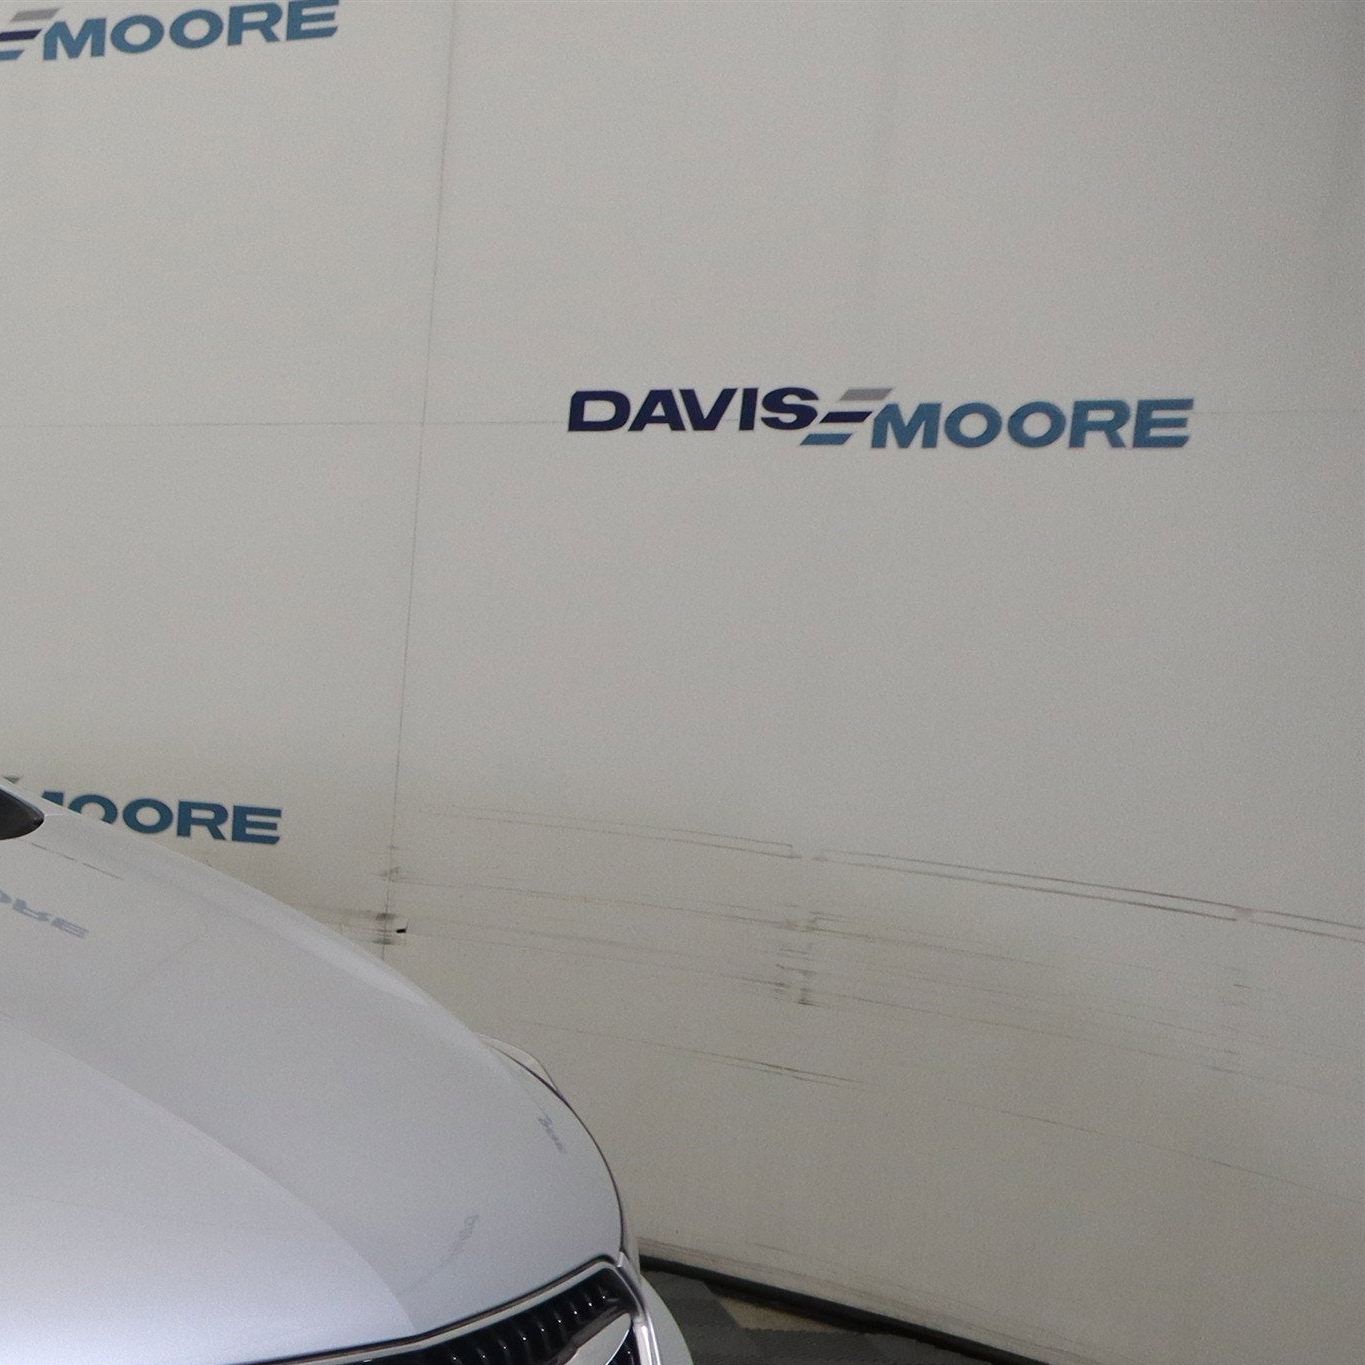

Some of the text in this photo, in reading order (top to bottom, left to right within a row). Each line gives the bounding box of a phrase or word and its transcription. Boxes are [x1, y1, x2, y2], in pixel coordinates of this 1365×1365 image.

[41, 0, 341, 61] MOORE
[567, 386, 1195, 449] DAVIS MOORE
[41, 790, 283, 845] OORE
